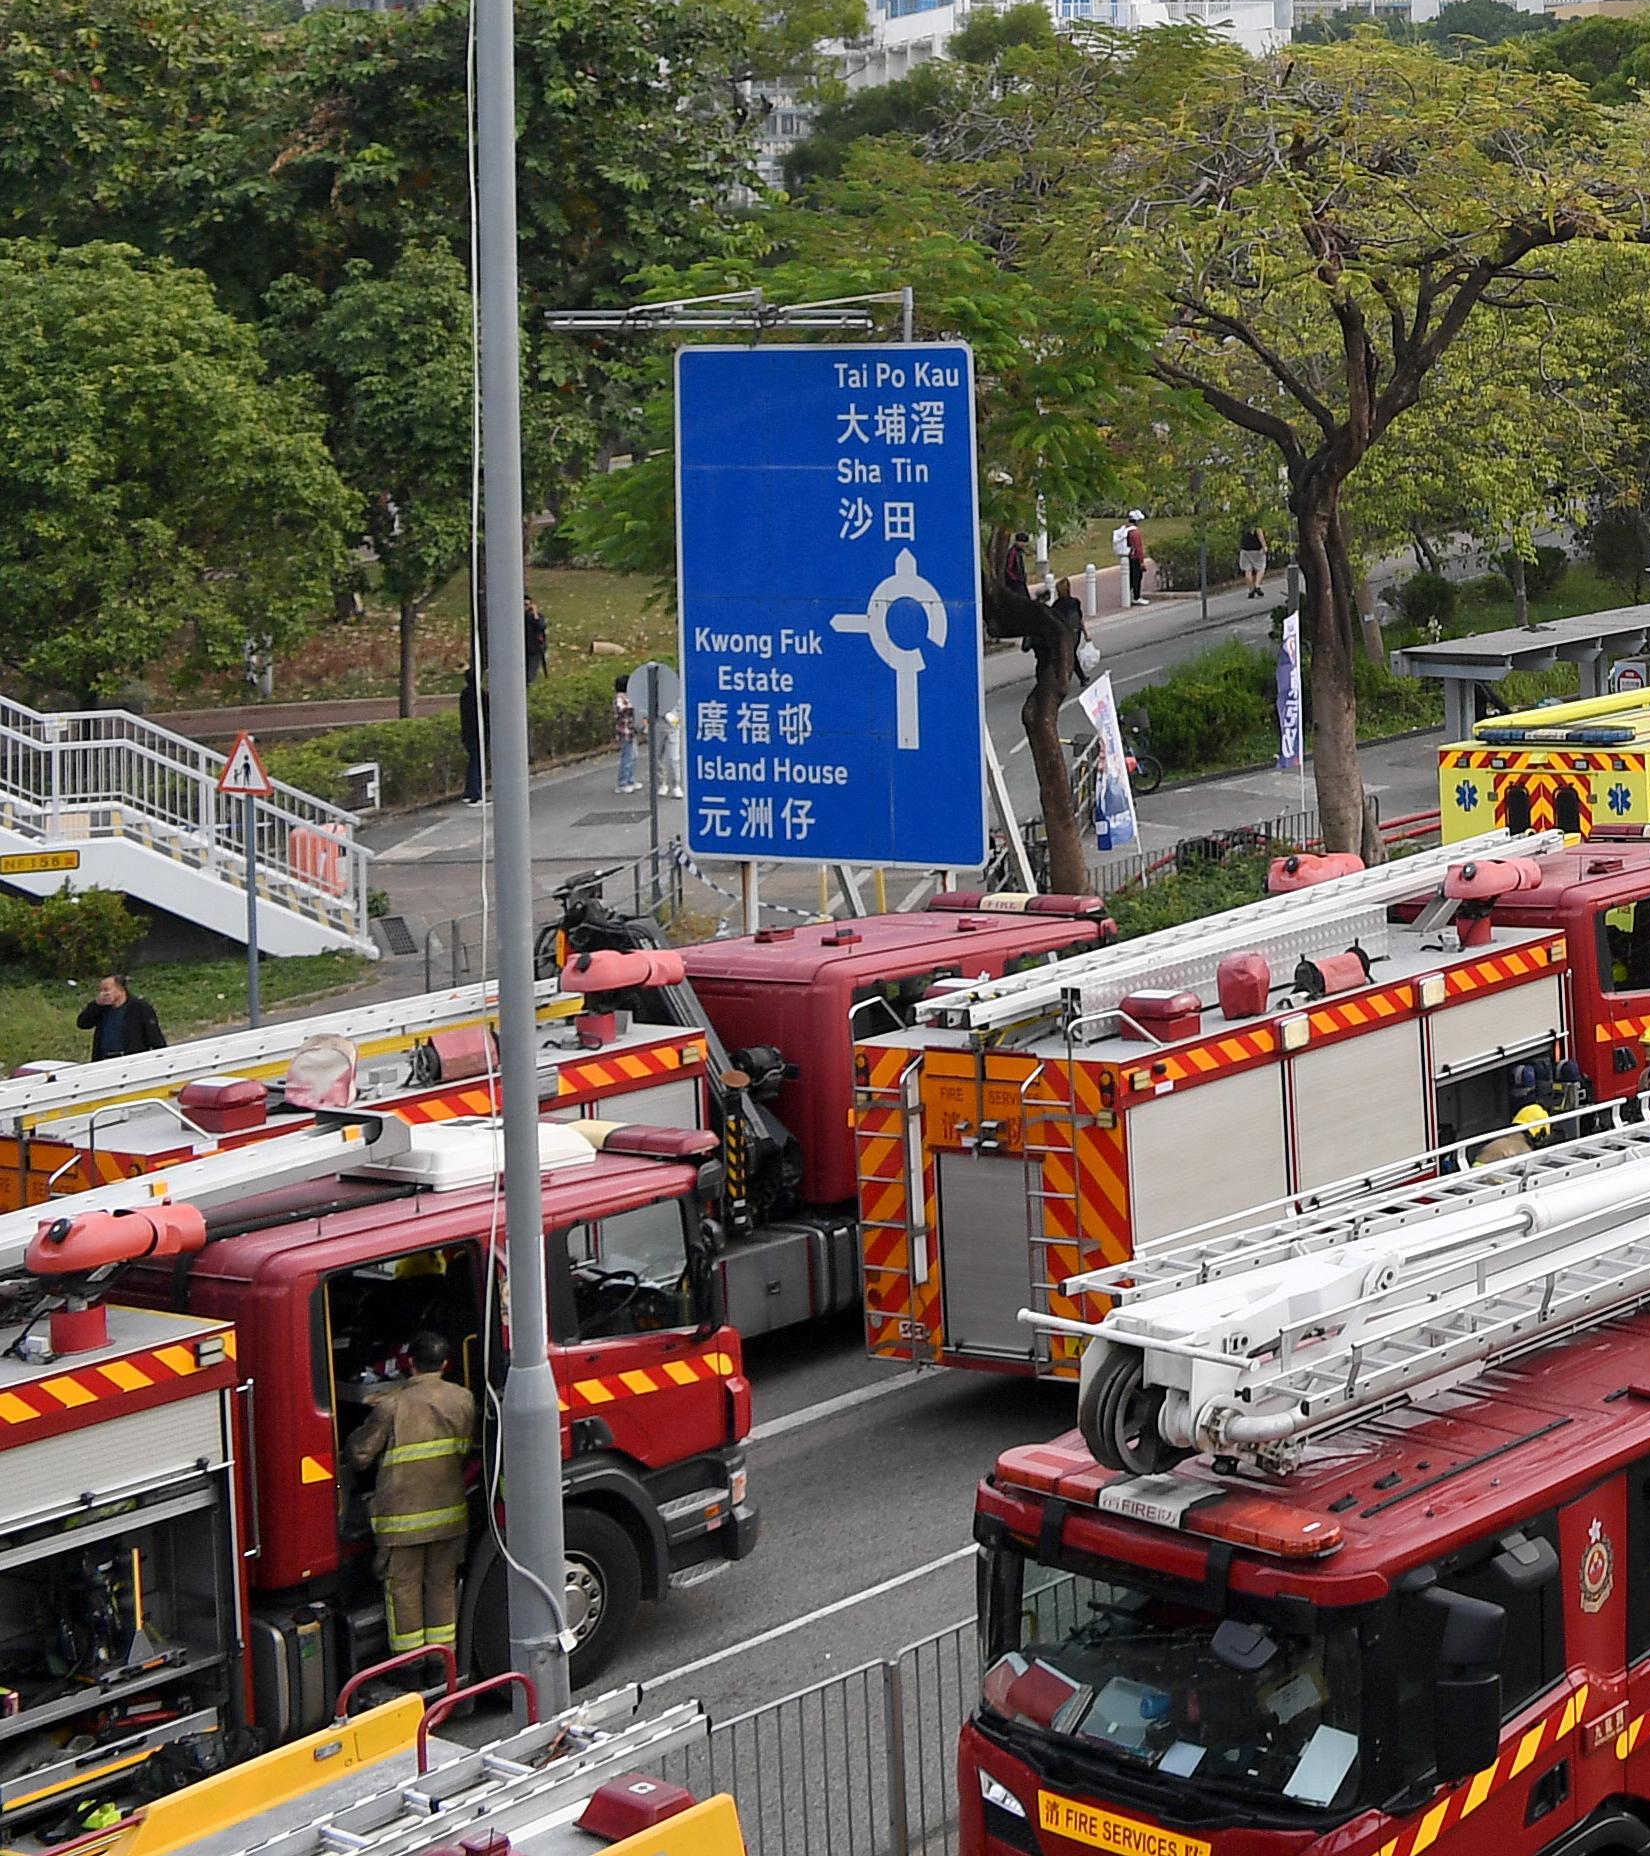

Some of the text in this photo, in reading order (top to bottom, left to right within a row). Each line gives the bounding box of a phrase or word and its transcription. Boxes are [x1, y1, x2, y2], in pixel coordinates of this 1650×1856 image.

[834, 362, 960, 389] Tai Po Kau
[837, 458, 929, 485] Sha Tin
[838, 497, 916, 542] 沙田
[695, 627, 823, 659] Kwong Fuk
[718, 666, 794, 693] Estate
[695, 700, 813, 747] 廣福邨
[696, 756, 849, 787] Island House
[698, 796, 816, 841] 元洲仔
[940, 1087, 963, 1102] FIRE
[1121, 1499, 1158, 1520] FIRE
[1065, 1808, 1098, 1838] FIRE
[1102, 1820, 1177, 1856] SERVICES
